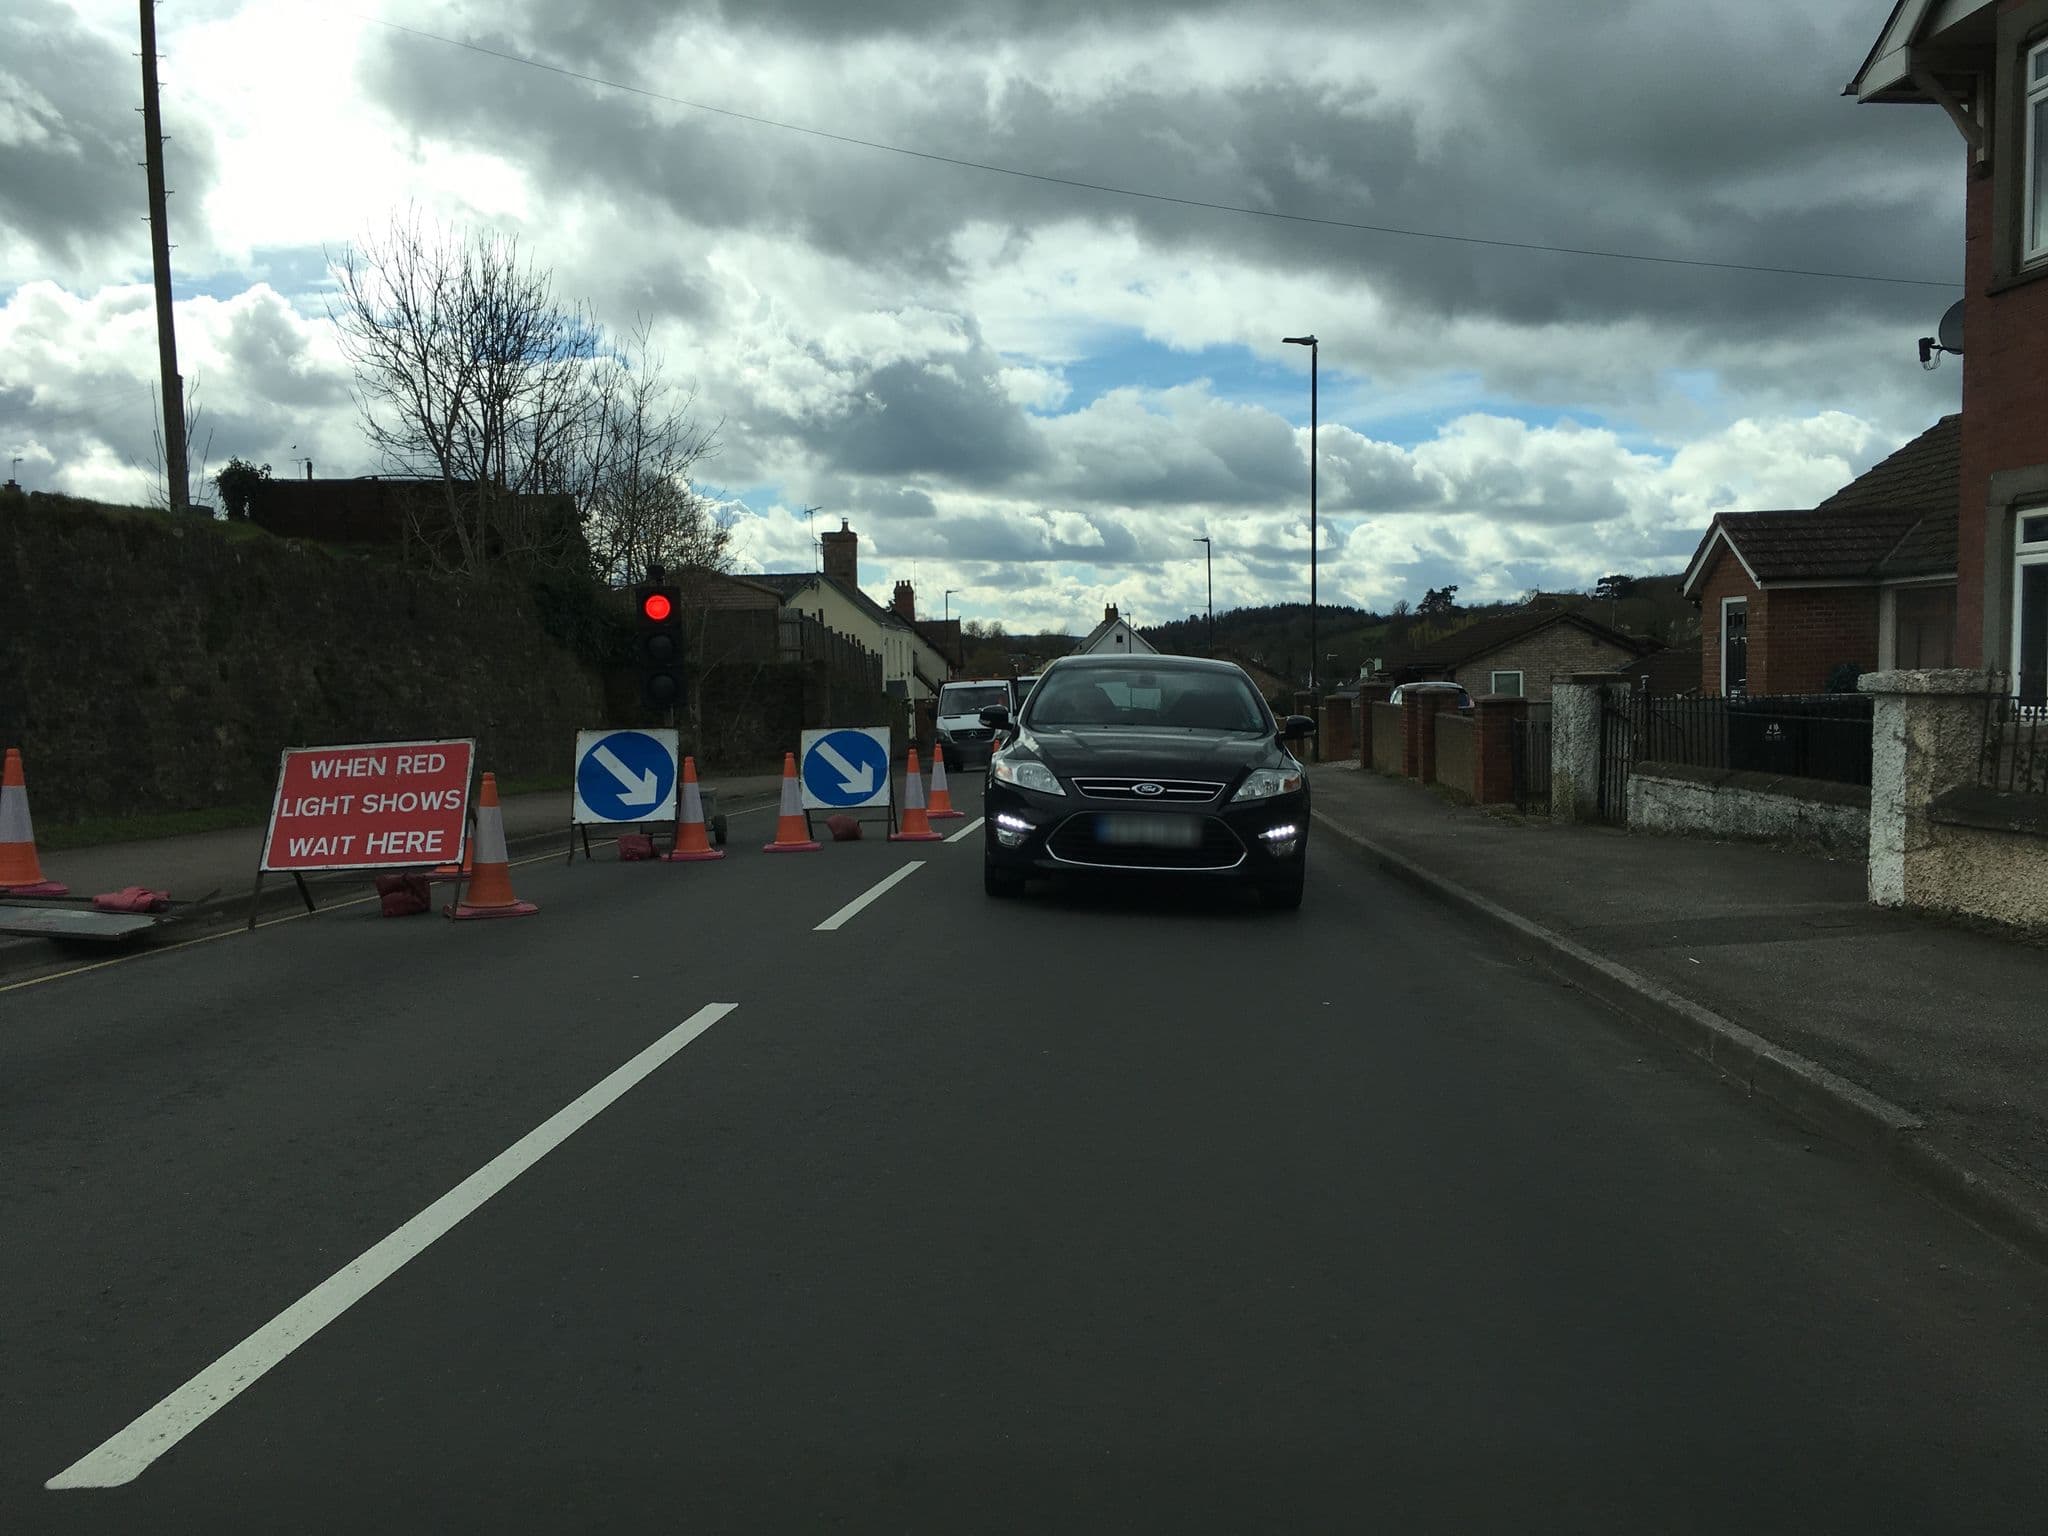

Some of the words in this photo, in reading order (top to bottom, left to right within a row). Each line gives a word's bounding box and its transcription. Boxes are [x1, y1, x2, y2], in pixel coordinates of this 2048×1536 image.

[310, 756, 387, 780] WHEN
[396, 753, 446, 775] RED
[280, 794, 356, 818] LIGHT
[360, 789, 461, 813] SHOWS
[288, 834, 356, 858] WAIT
[366, 829, 445, 856] HERE
